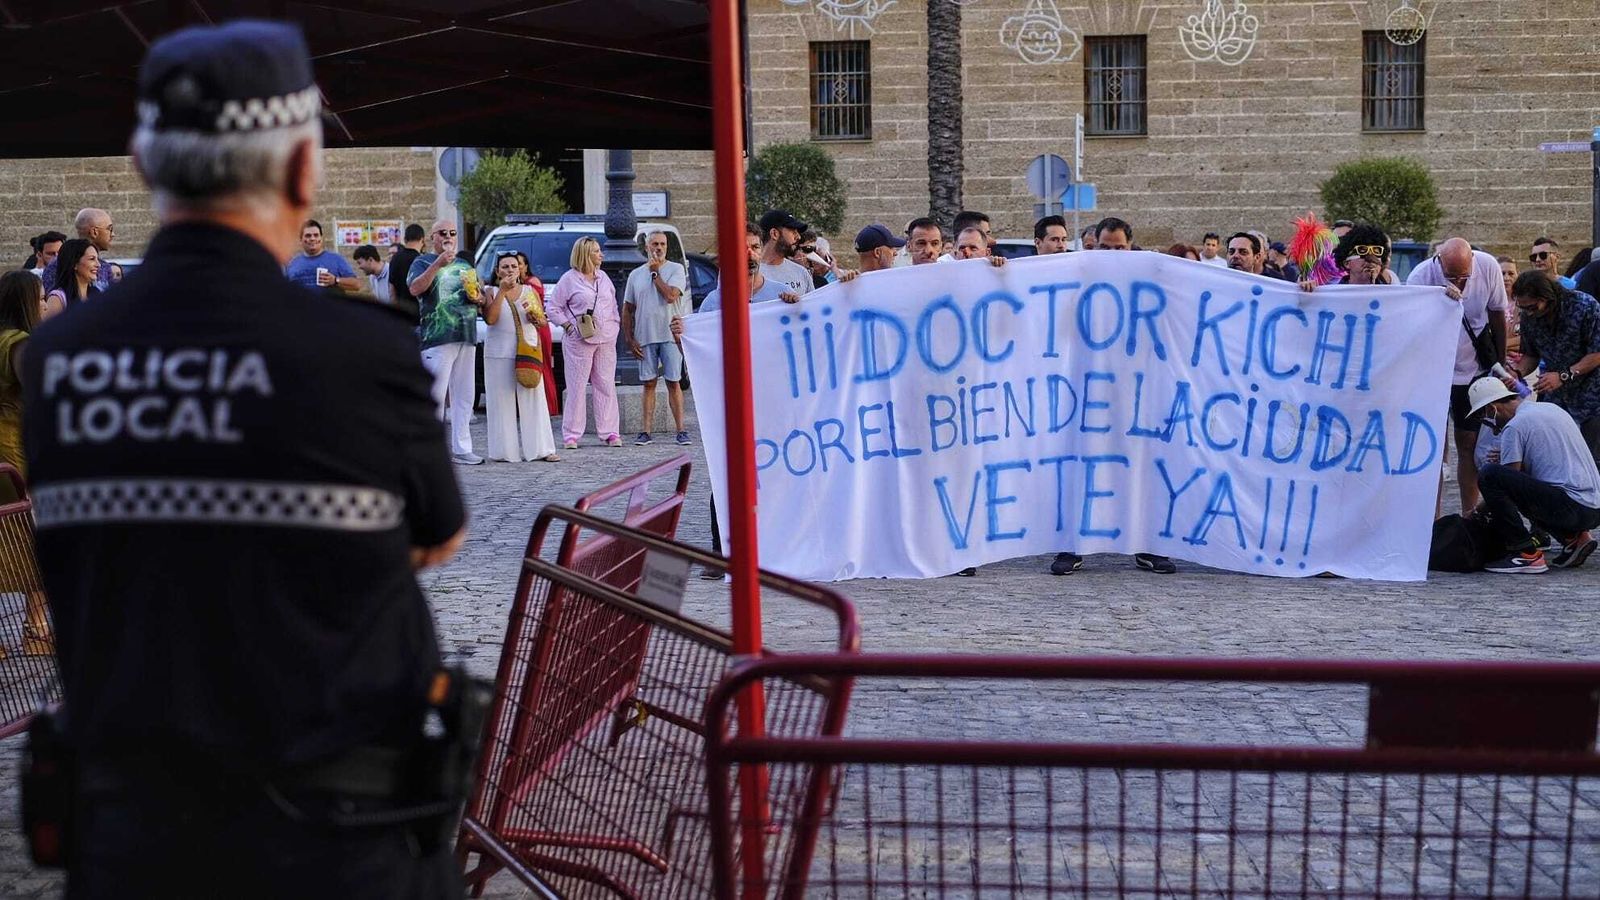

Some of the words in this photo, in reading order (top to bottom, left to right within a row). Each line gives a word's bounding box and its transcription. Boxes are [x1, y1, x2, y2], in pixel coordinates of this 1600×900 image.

[44, 348, 273, 395] POLICIA
[58, 397, 242, 443] LOCAL
[857, 400, 922, 460] EL
[1046, 371, 1116, 433] DE
[1126, 371, 1198, 448] LA
[933, 455, 1131, 550] VETE
